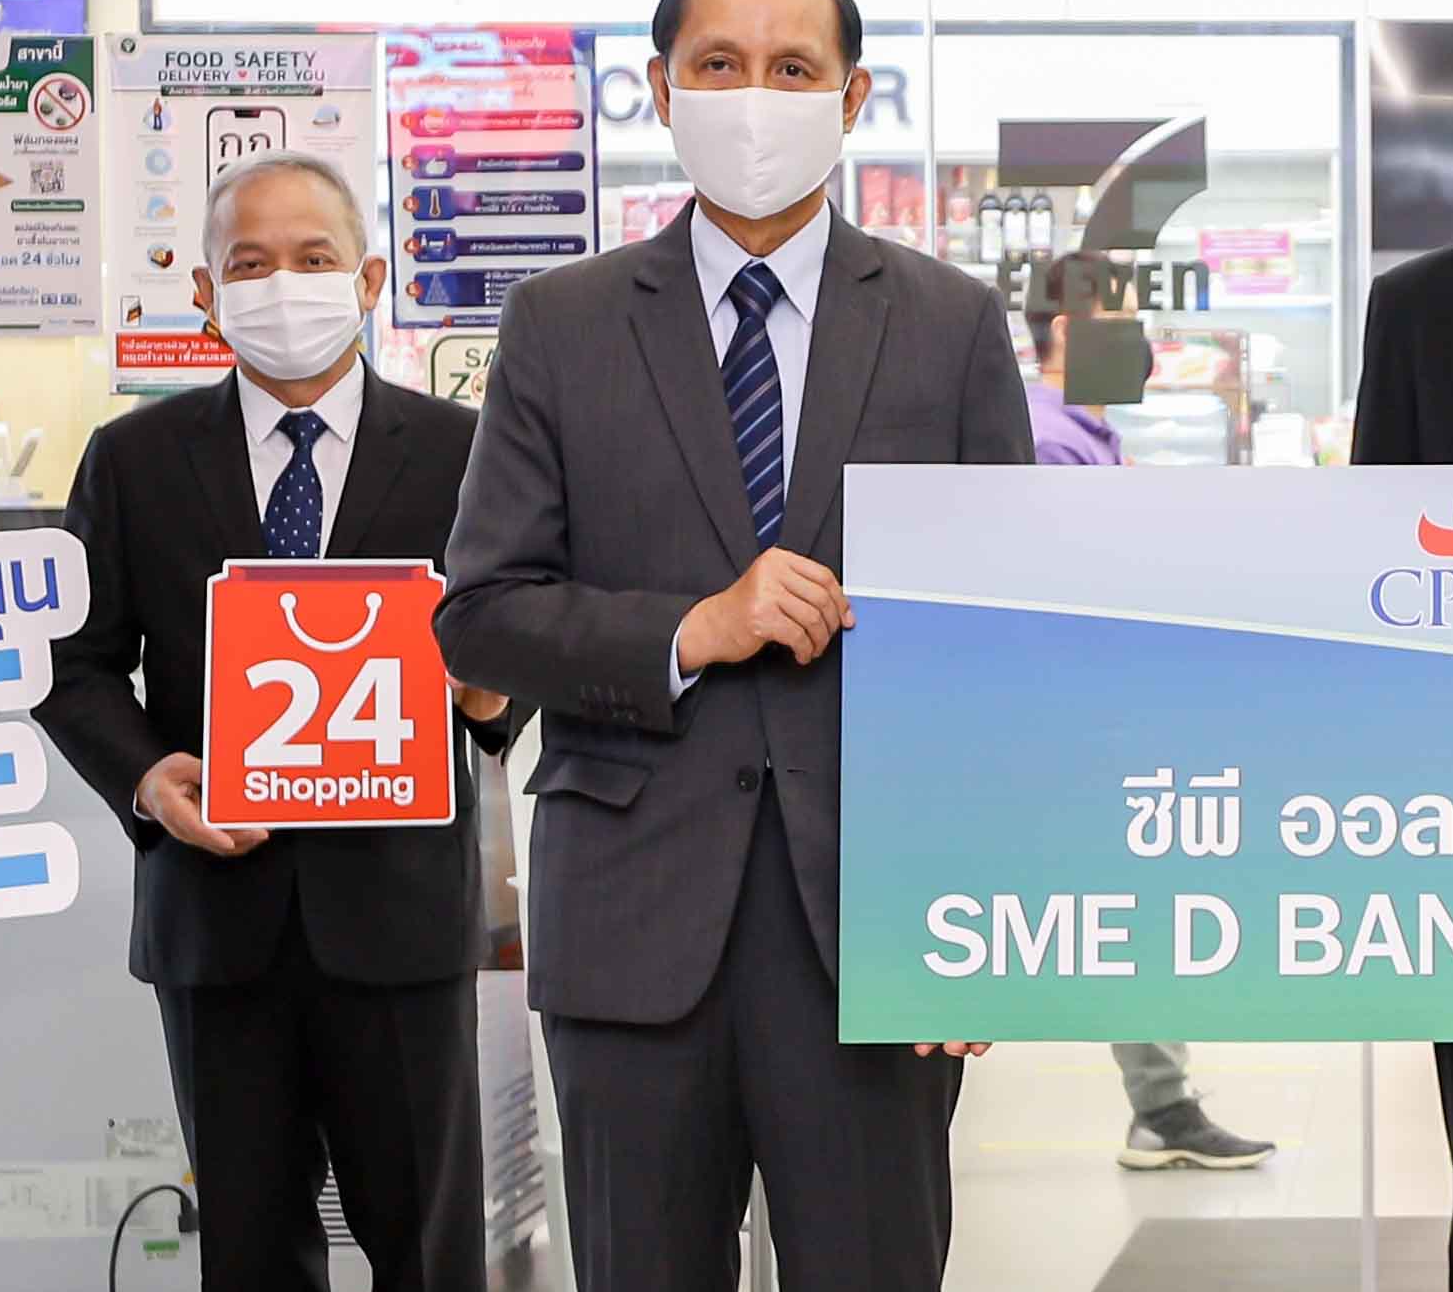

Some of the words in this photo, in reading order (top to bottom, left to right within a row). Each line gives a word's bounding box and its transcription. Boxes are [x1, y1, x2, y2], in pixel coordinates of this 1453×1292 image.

[157, 69, 231, 82] DELIVERY
[258, 69, 286, 82] FOR
[295, 69, 326, 82] YOU
[165, 51, 223, 68] FOOD
[234, 51, 317, 68] SAFETY
[22, 252, 42, 266] 24
[243, 657, 415, 767] 24
[244, 769, 415, 807] Shopping
[1122, 766, 1241, 857] ซีพี
[922, 893, 1136, 977] SME
[1173, 893, 1240, 976] D
